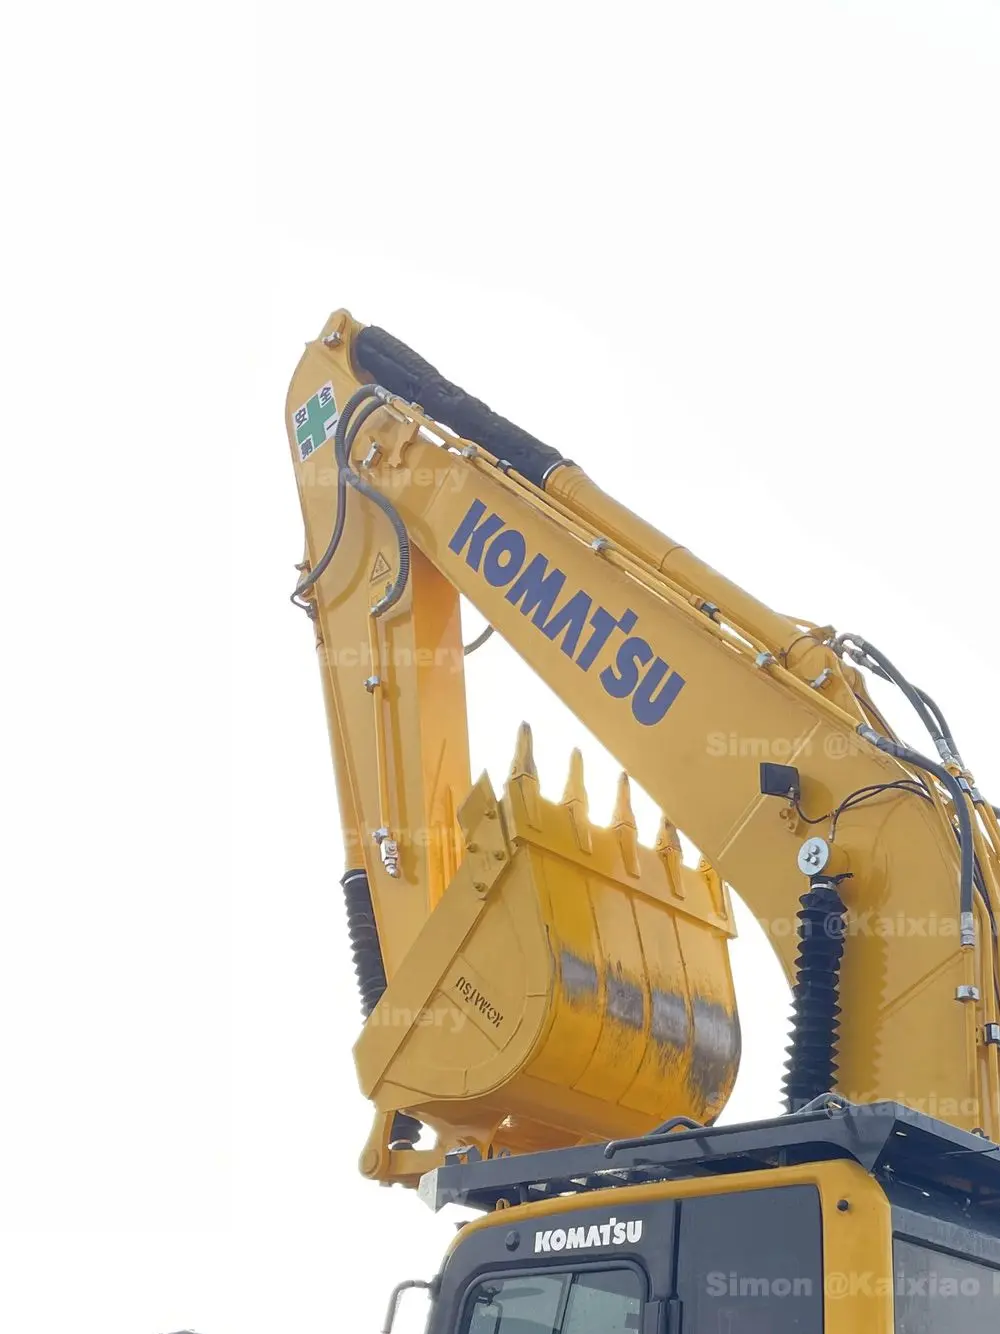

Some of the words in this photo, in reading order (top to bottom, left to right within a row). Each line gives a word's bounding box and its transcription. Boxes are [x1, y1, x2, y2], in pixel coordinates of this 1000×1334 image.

[448, 498, 686, 726] KOMATSU
[455, 977, 503, 1028] KOMATSU
[534, 1217, 643, 1253] KOMATSU
